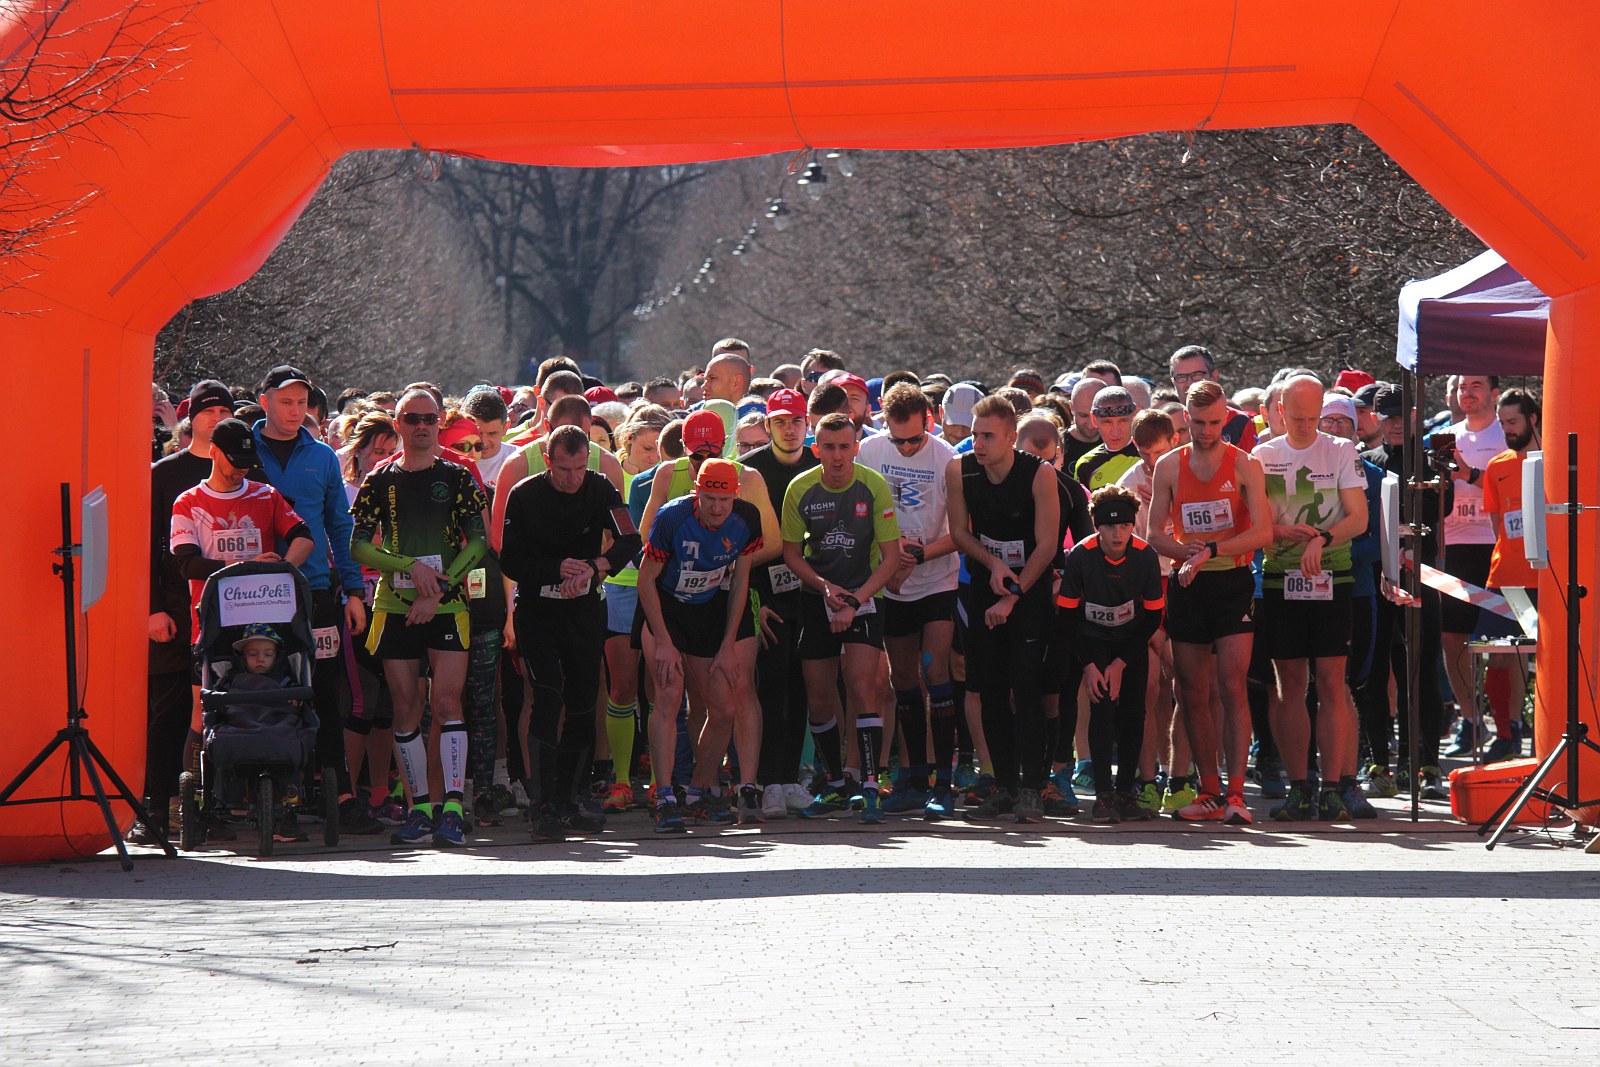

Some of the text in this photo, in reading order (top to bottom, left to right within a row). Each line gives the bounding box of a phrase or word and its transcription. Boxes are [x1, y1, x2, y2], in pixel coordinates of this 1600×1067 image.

[705, 480, 728, 490] CCC
[810, 501, 835, 510] KGHM
[1457, 504, 1475, 516] 104
[1187, 510, 1212, 526] 156
[217, 537, 245, 552] 068
[684, 577, 707, 588] 192
[1287, 578, 1313, 592] 085
[224, 584, 283, 600] ChruPek
[1090, 610, 1114, 621] 128
[315, 636, 332, 650] 49
